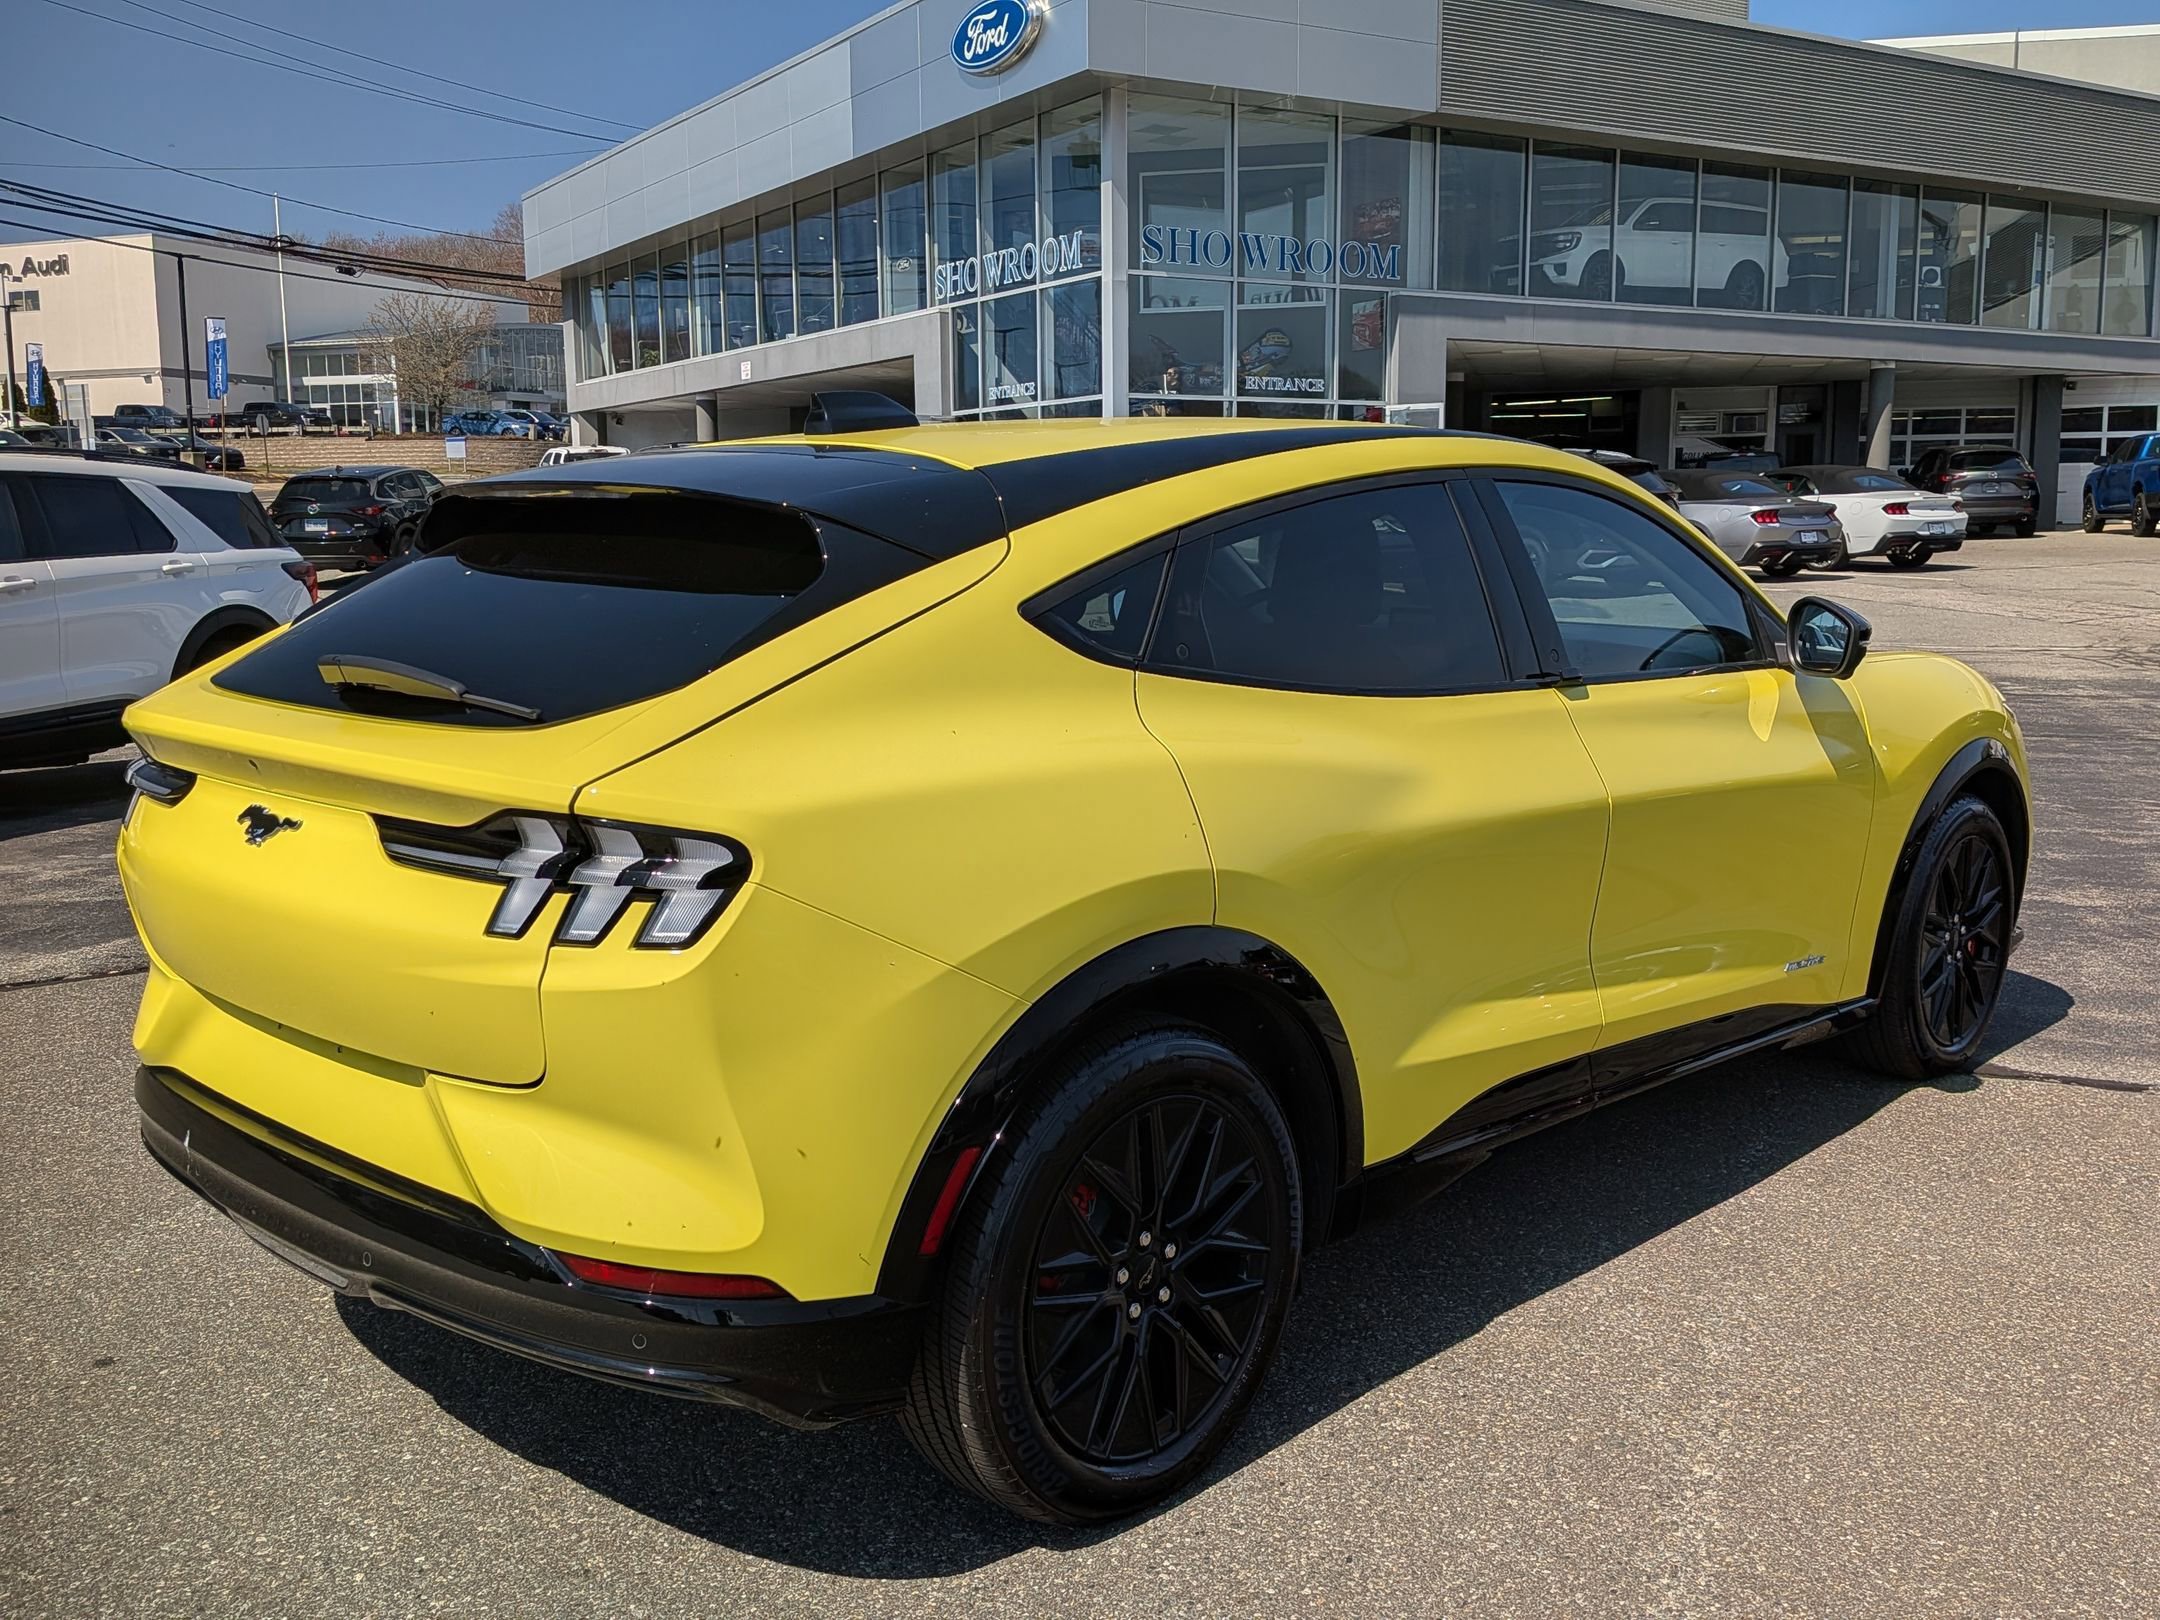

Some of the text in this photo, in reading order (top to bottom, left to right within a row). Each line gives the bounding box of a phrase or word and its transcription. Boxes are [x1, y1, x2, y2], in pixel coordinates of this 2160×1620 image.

[964, 9, 1009, 60] Ford
[21, 254, 70, 278] Audi
[934, 230, 1083, 300] SHOWROOM
[1141, 224, 1401, 280] SHOWROOM
[214, 343, 222, 397] HYUNDAI
[988, 382, 1036, 400] ENTRANCE
[1244, 376, 1325, 392] ENTRANCE
